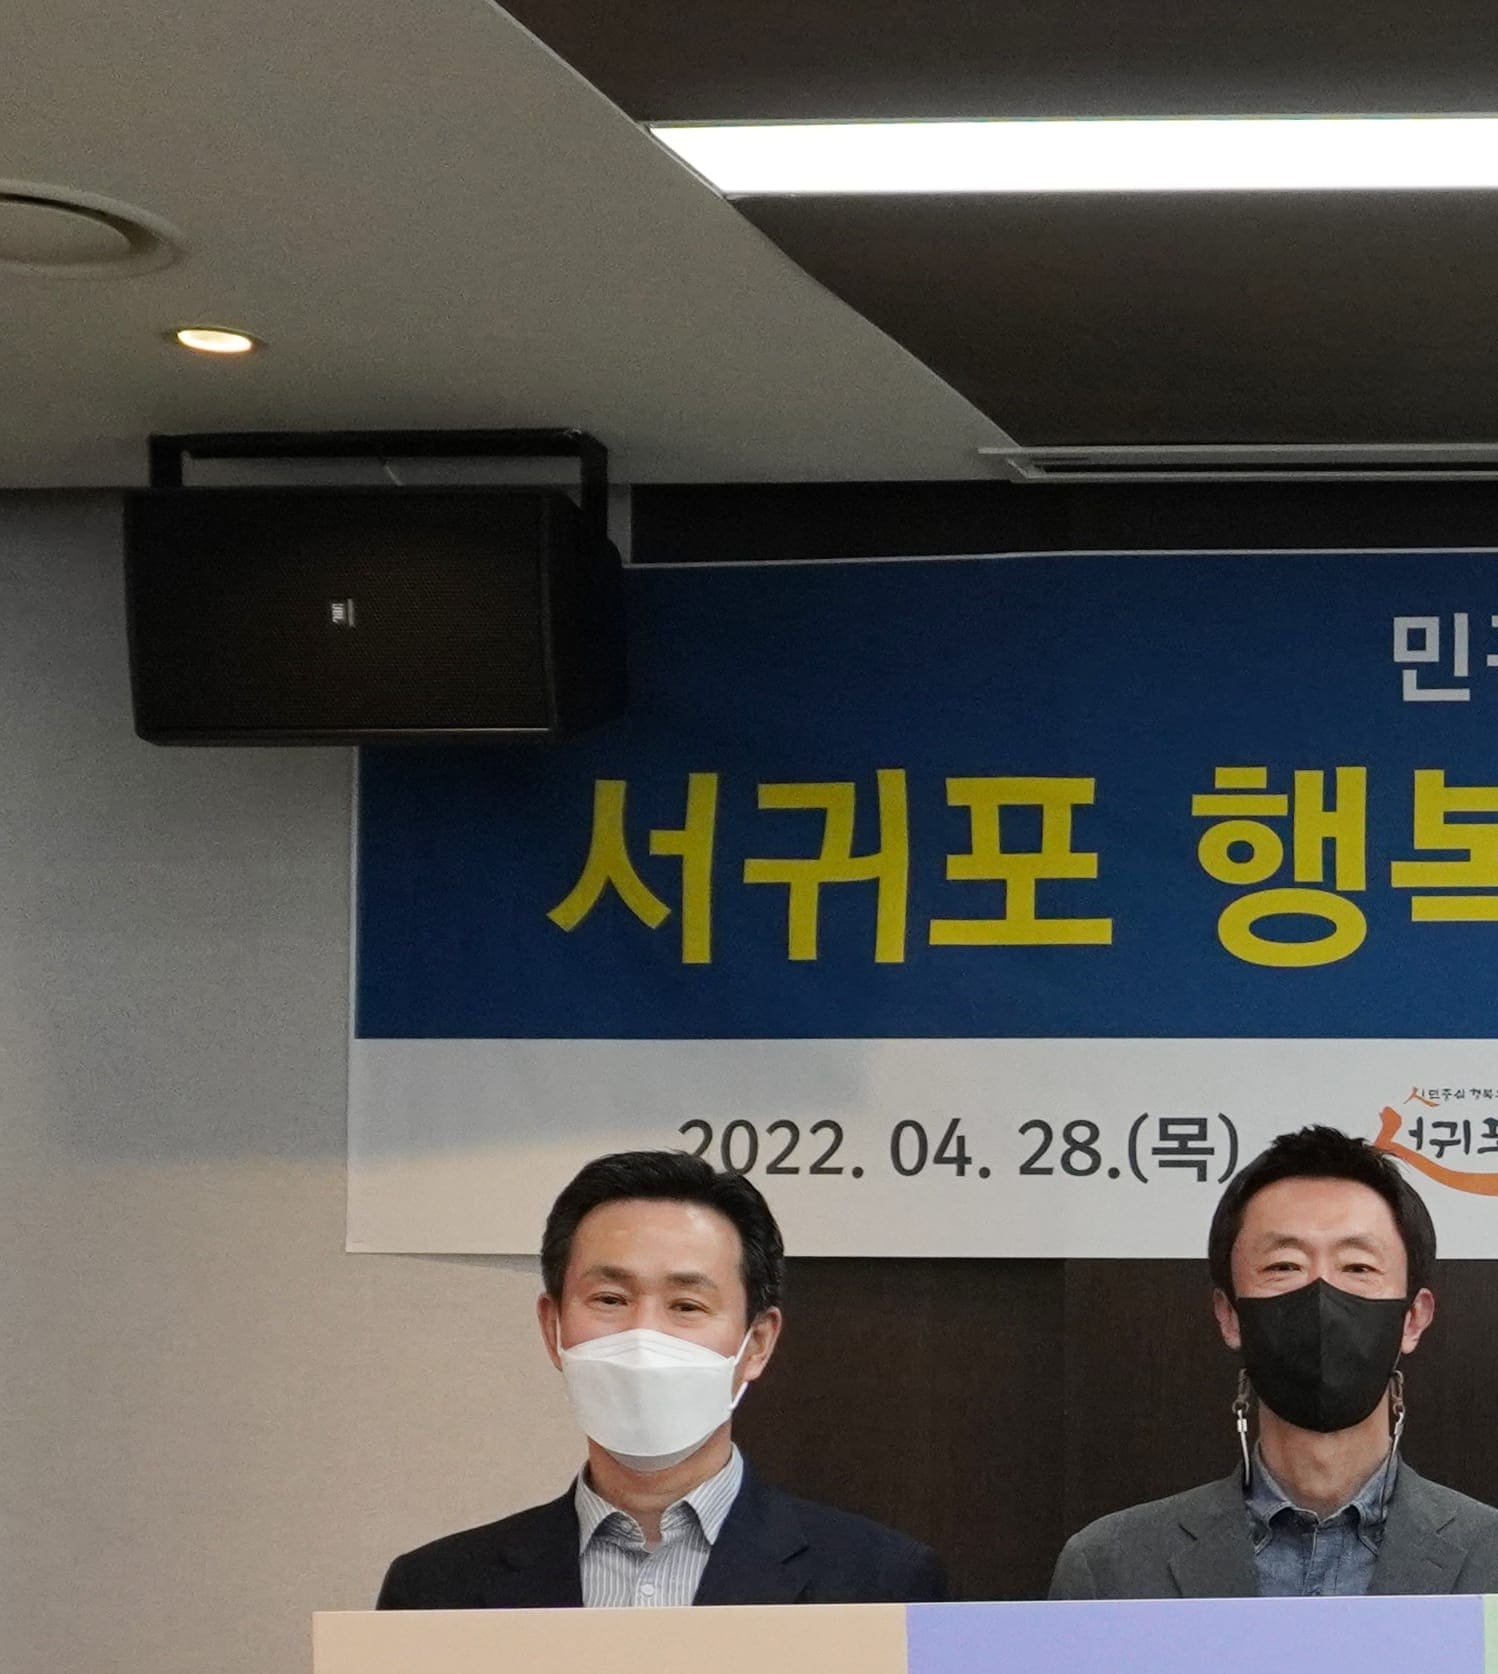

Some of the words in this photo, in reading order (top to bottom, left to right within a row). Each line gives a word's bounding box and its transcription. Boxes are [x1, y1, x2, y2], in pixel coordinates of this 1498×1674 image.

[548, 770, 1114, 965] 서귀포
[677, 1118, 864, 1179] 2022.
[889, 1117, 991, 1180] 04.
[1017, 1112, 1240, 1185] 28.(목)
